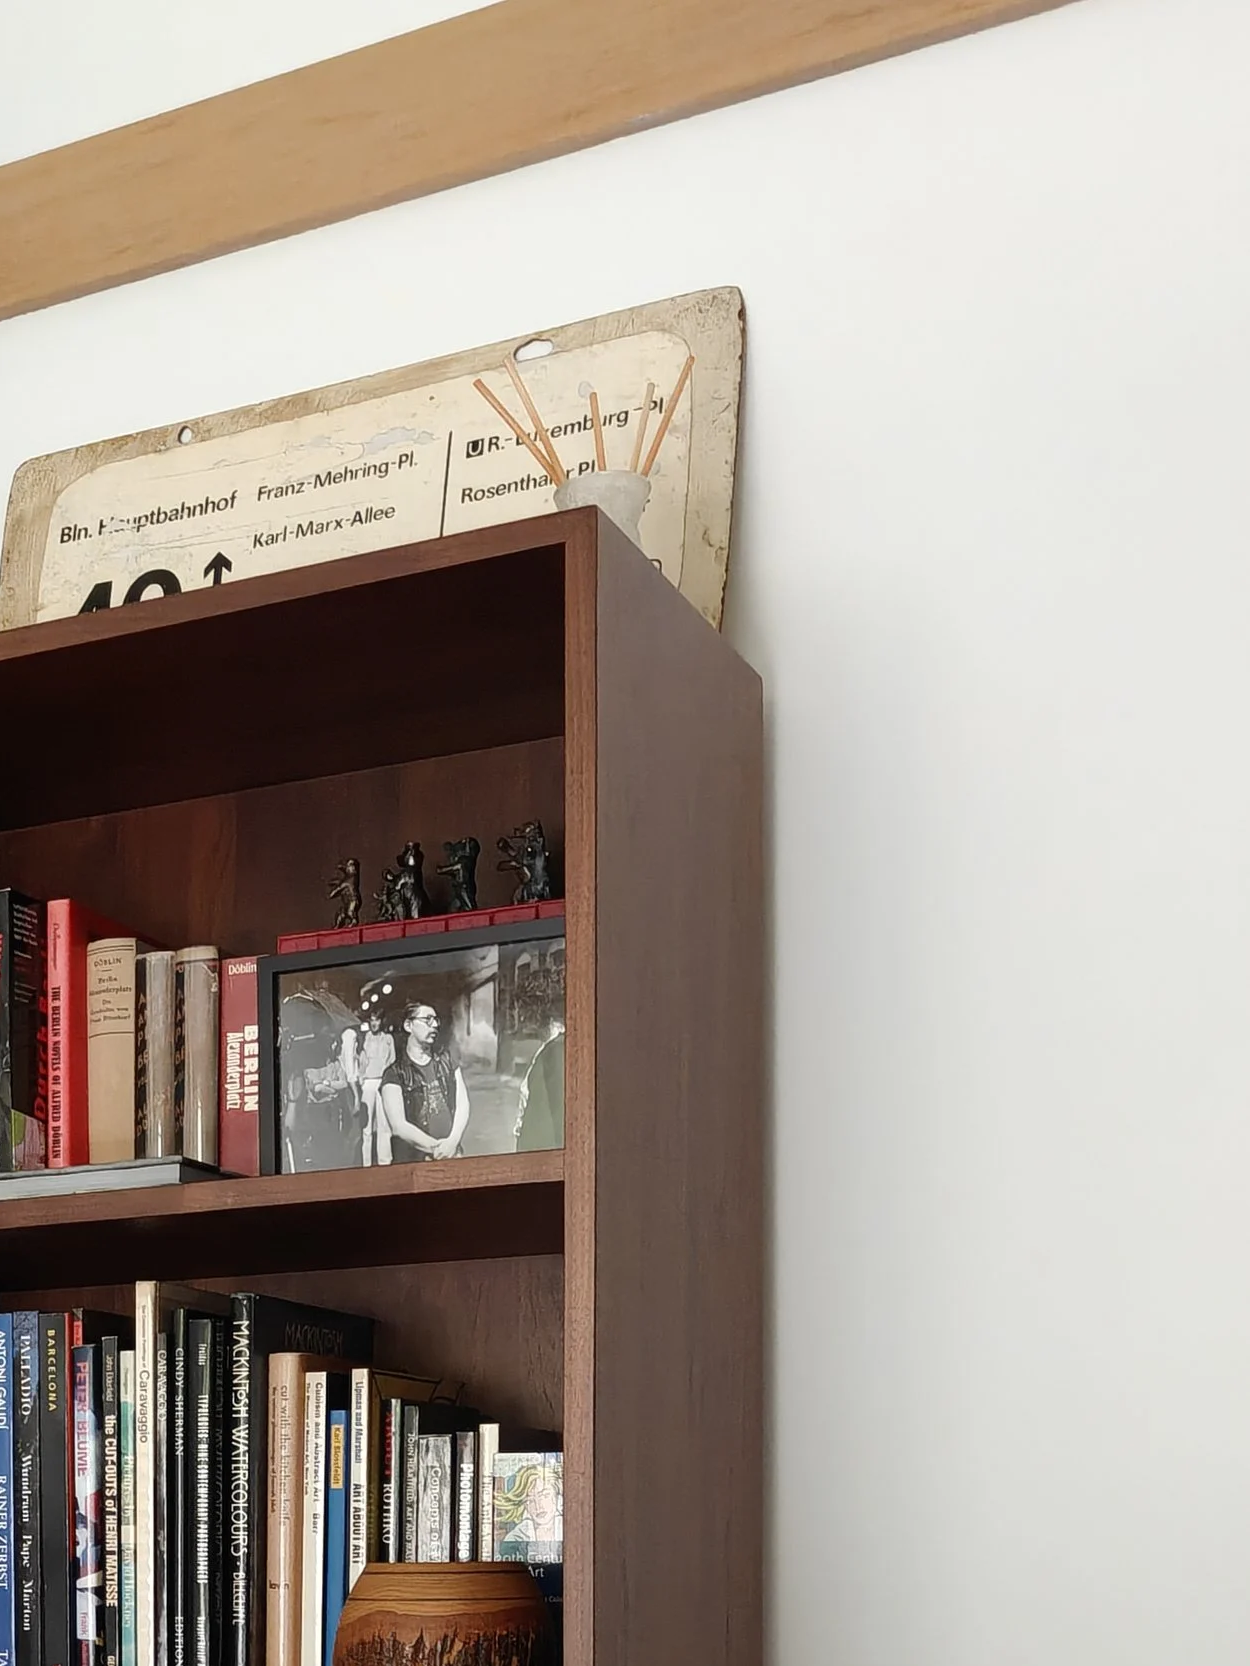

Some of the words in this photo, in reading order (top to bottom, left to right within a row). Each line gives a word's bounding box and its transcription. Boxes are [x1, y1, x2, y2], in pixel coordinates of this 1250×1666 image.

[257, 451, 419, 502] Franz-Mehring-Pl.
[59, 524, 93, 544] Bln.
[99, 489, 239, 537] Huptbahnhof
[252, 504, 397, 550] Karl-Marx-Allee
[228, 962, 257, 975] Döblin
[226, 1032, 243, 1111] Alexanderplatz
[244, 1025, 259, 1112] BERLIN
[20, 1335, 31, 1415] PALLADIO
[48, 1329, 57, 1411] BARCELONA
[175, 1347, 184, 1388] CINDY
[105, 1415, 117, 1435] the
[137, 1369, 151, 1443] Caravaggio
[175, 1394, 184, 1456] SHERMAN
[354, 1413, 363, 1427] and
[333, 1428, 342, 1443] Karl
[354, 1429, 363, 1464] Marshall
[406, 1433, 414, 1455] JOHN
[105, 1438, 117, 1496] CUT-OUTS
[333, 1445, 342, 1485] Blossfeldt
[105, 1499, 117, 1512] of
[231, 1424, 250, 1557] WATERCOLOURS
[352, 1484, 365, 1503] ART
[352, 1506, 365, 1542] ABOUT
[458, 1463, 473, 1560] Photomontage
[105, 1515, 117, 1552] HENRI
[352, 1545, 365, 1565] ART
[106, 1556, 118, 1607] MATISSE
[80, 1612, 88, 1636] Frank
